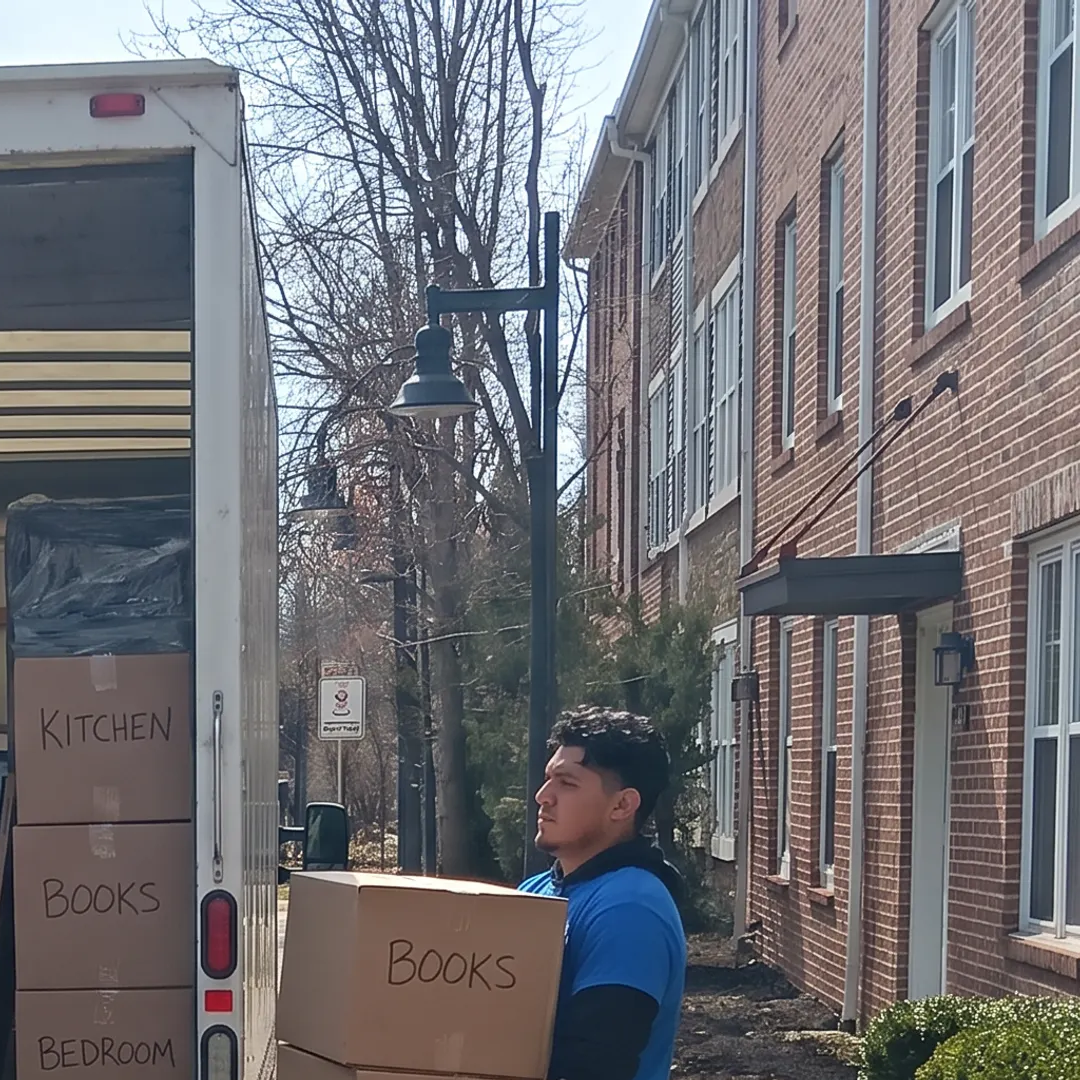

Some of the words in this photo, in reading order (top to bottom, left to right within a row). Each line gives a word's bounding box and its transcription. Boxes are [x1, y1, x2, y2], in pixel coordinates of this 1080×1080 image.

[40, 706, 173, 750] KITCHEN
[42, 878, 161, 919] BOOKS
[387, 938, 517, 991] BOOKS
[37, 1035, 177, 1071] BEDROOM
